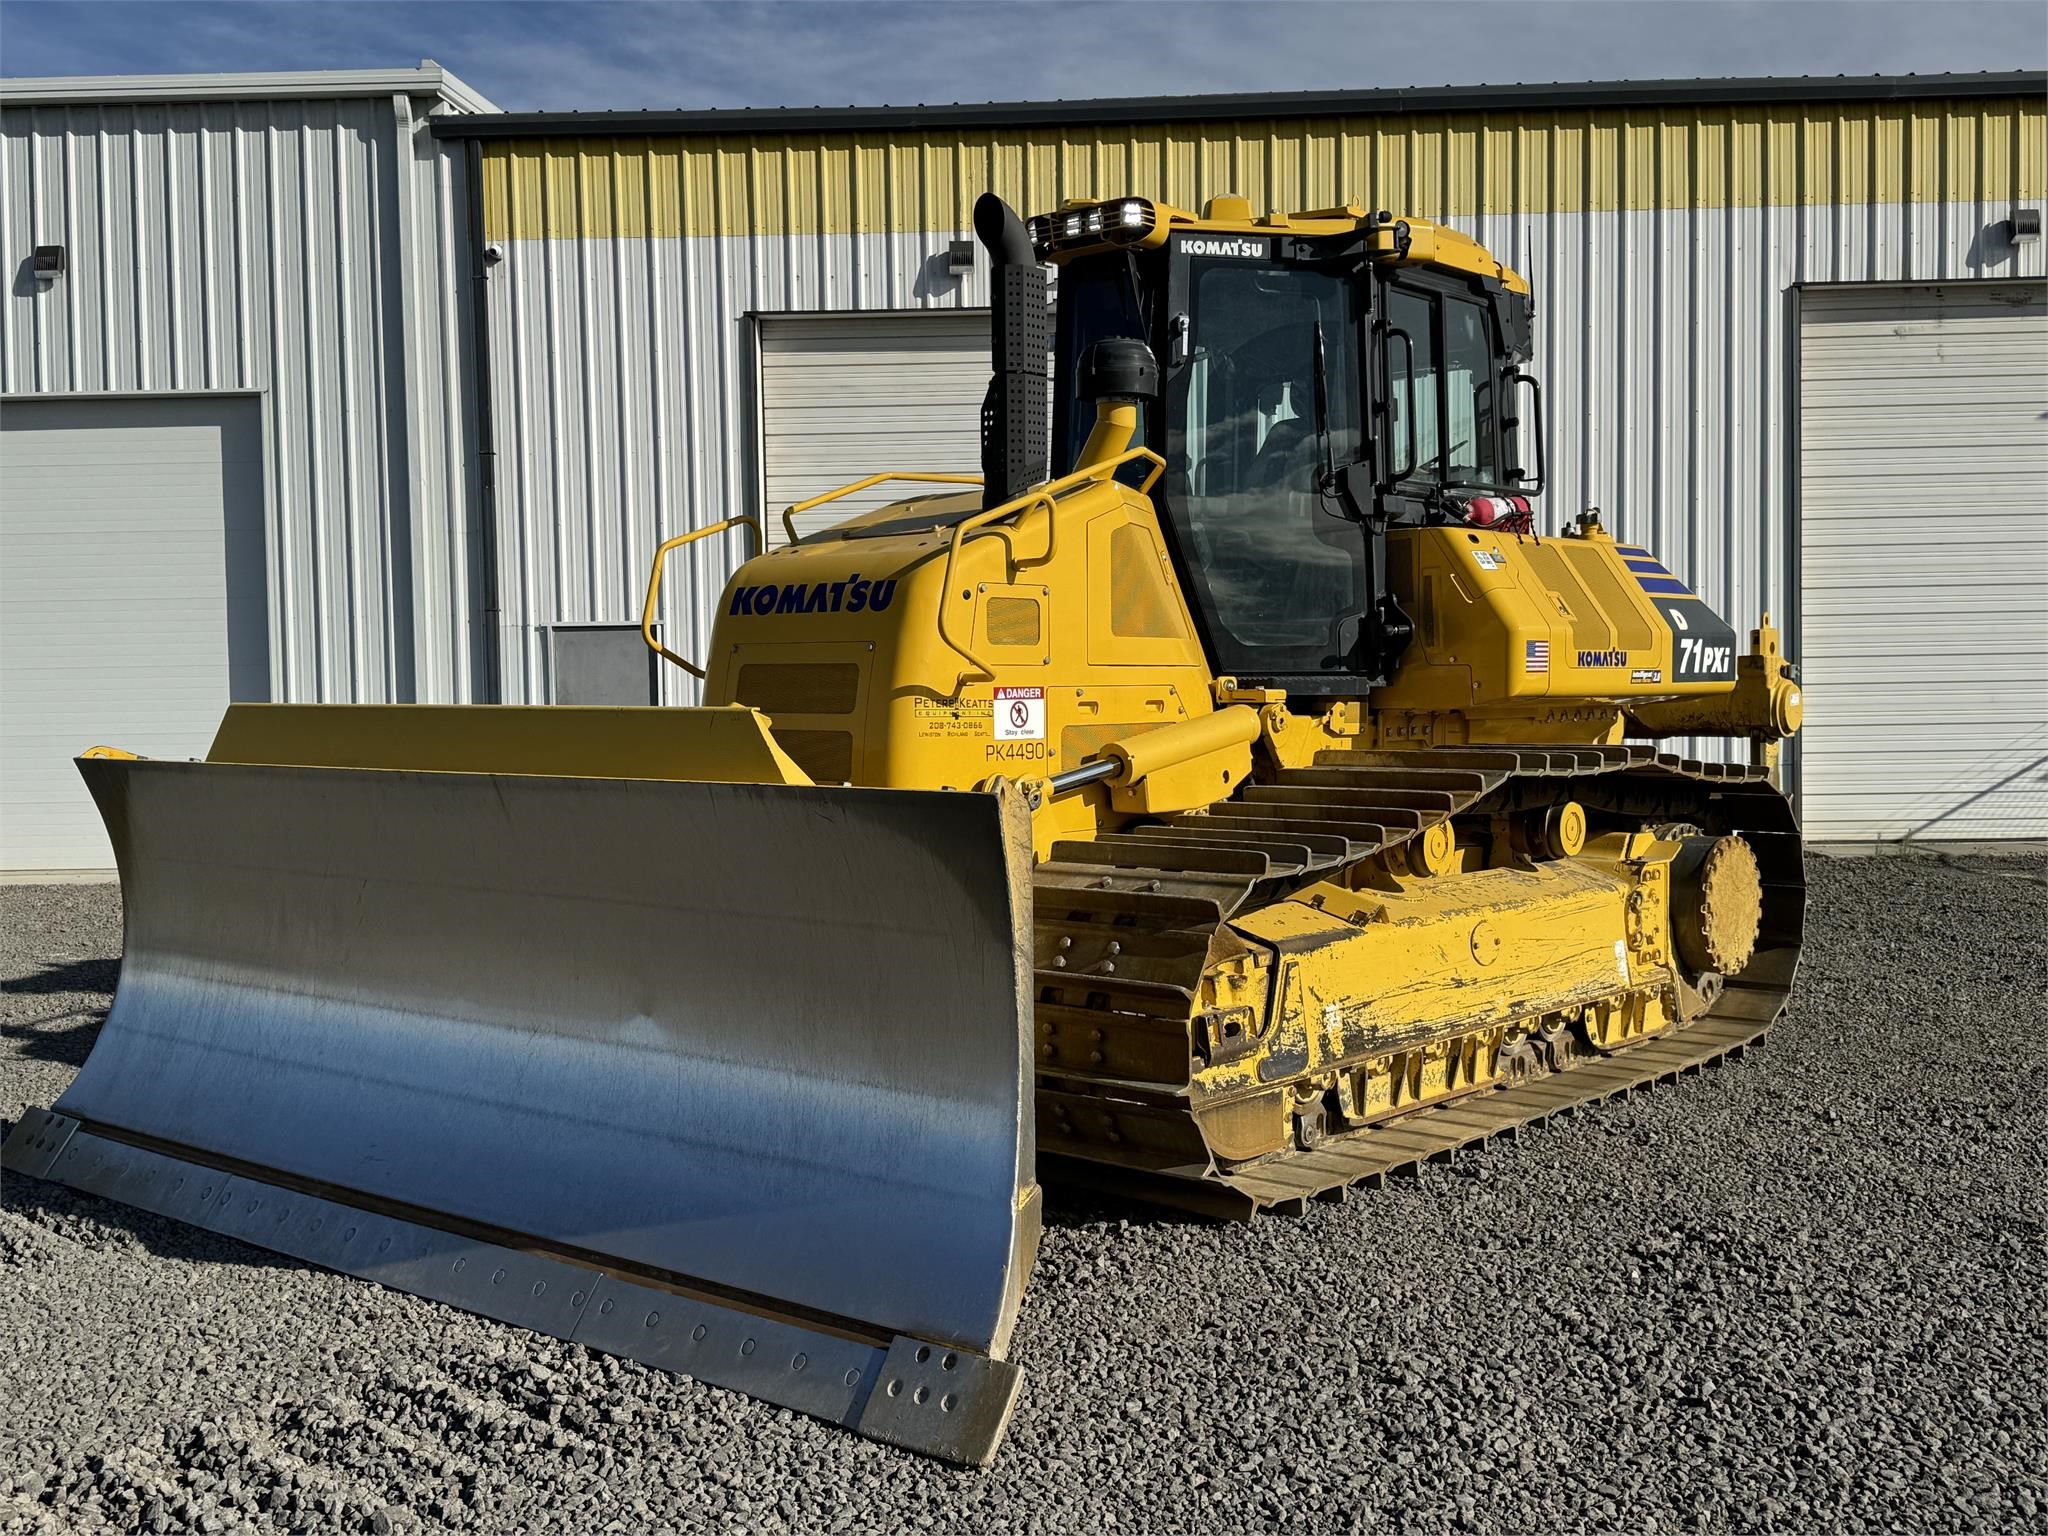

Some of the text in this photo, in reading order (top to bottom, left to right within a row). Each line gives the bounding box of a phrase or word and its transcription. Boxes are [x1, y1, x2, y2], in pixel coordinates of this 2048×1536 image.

[1180, 239, 1263, 257] KOMATSU
[729, 573, 898, 616] KOMATSU
[1669, 609, 1688, 630] D
[1577, 647, 1627, 667] KOMATSU
[1006, 688, 1041, 698] DANGER
[929, 722, 983, 730] 208-743-0866
[986, 742, 1045, 762] PK4490
